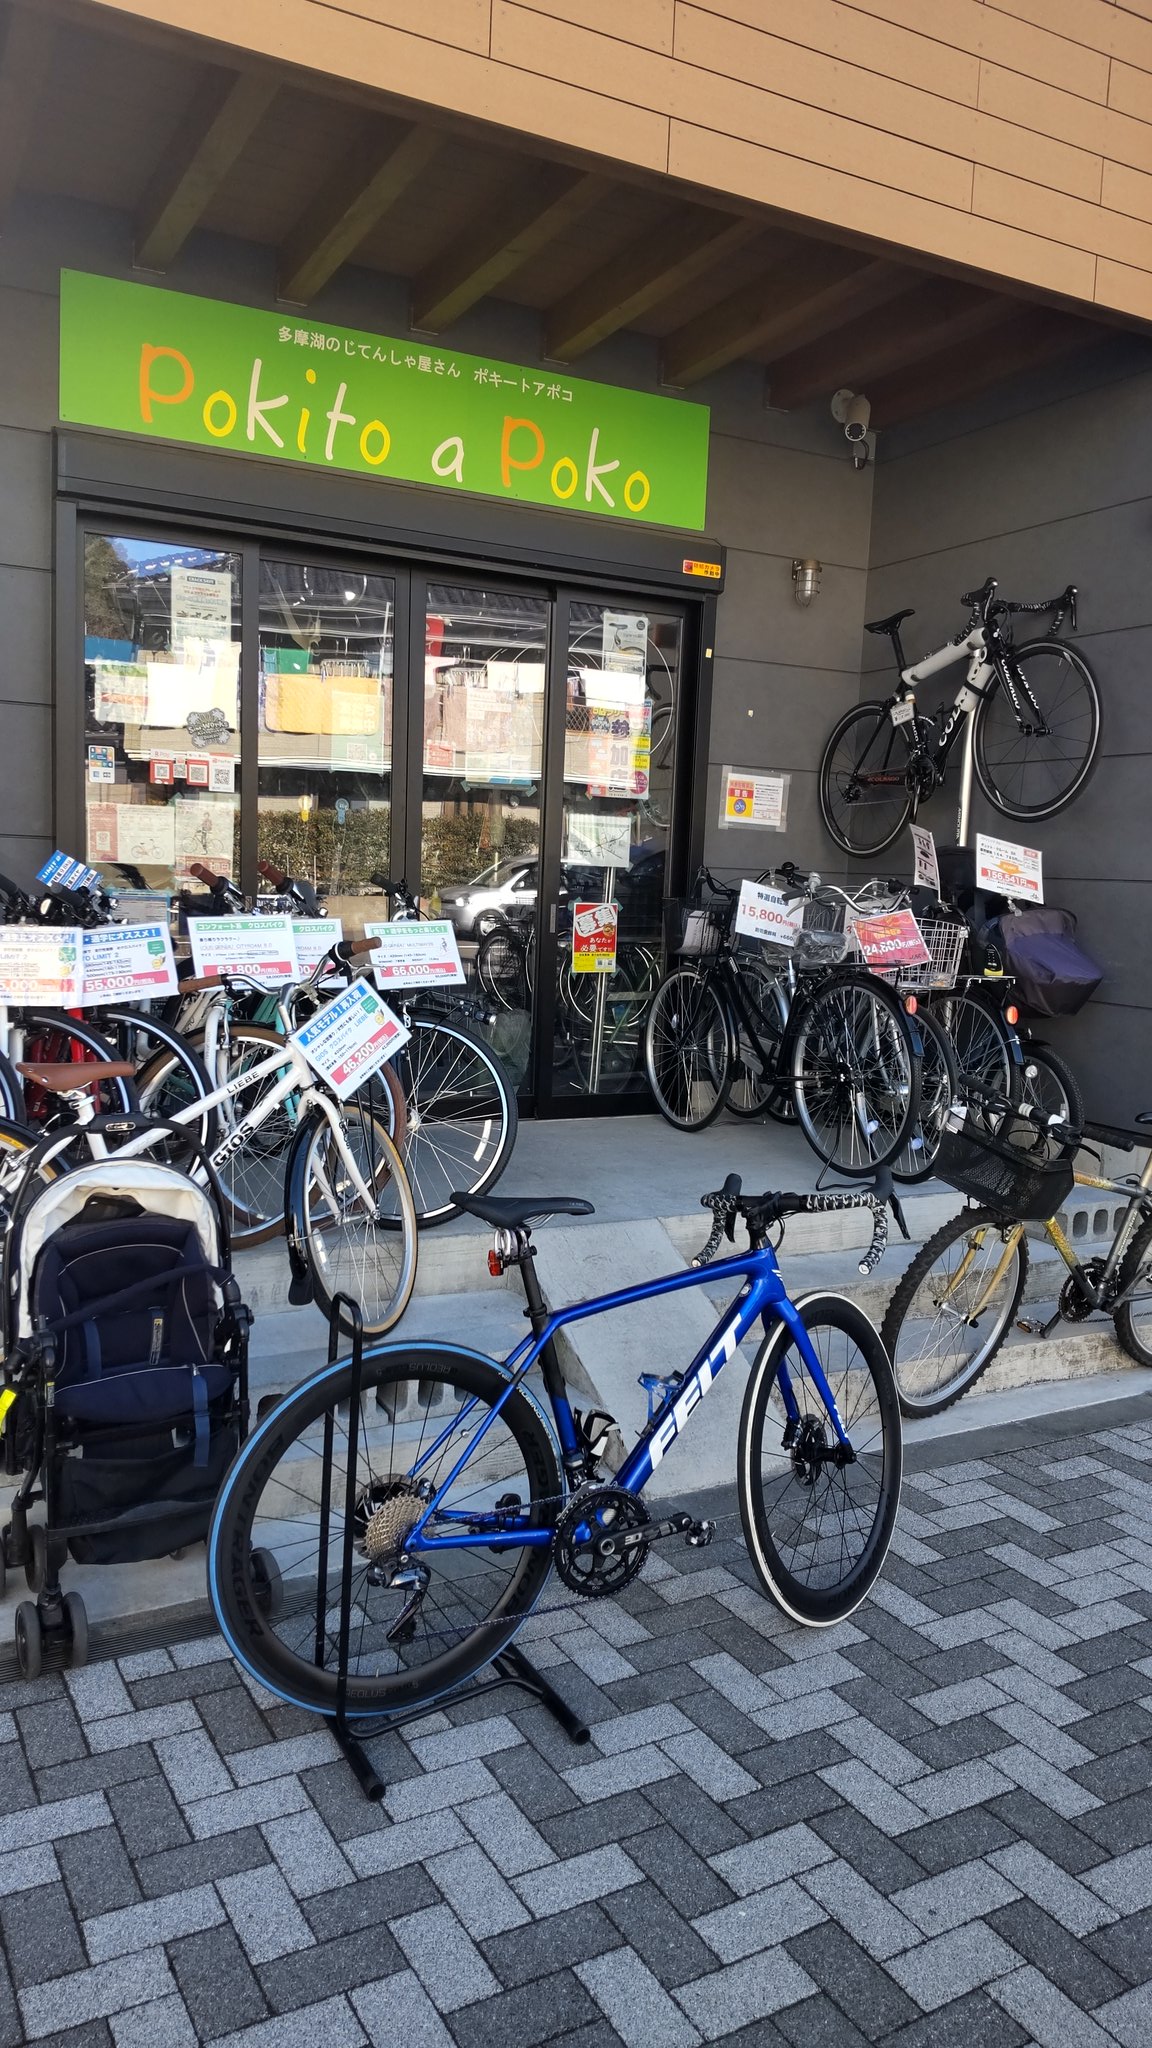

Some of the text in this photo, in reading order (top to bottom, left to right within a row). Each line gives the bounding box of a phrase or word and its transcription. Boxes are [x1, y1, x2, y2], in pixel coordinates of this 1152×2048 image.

[278, 324, 573, 402] 多摩湖のじてんしゃ屋さん ポキートアポコ
[139, 343, 650, 513] Pokito a Poko
[247, 921, 283, 929] クロスバイク
[227, 1070, 260, 1094] LIEBE
[212, 1122, 255, 1167] GIOS
[649, 1312, 743, 1471] FELT
